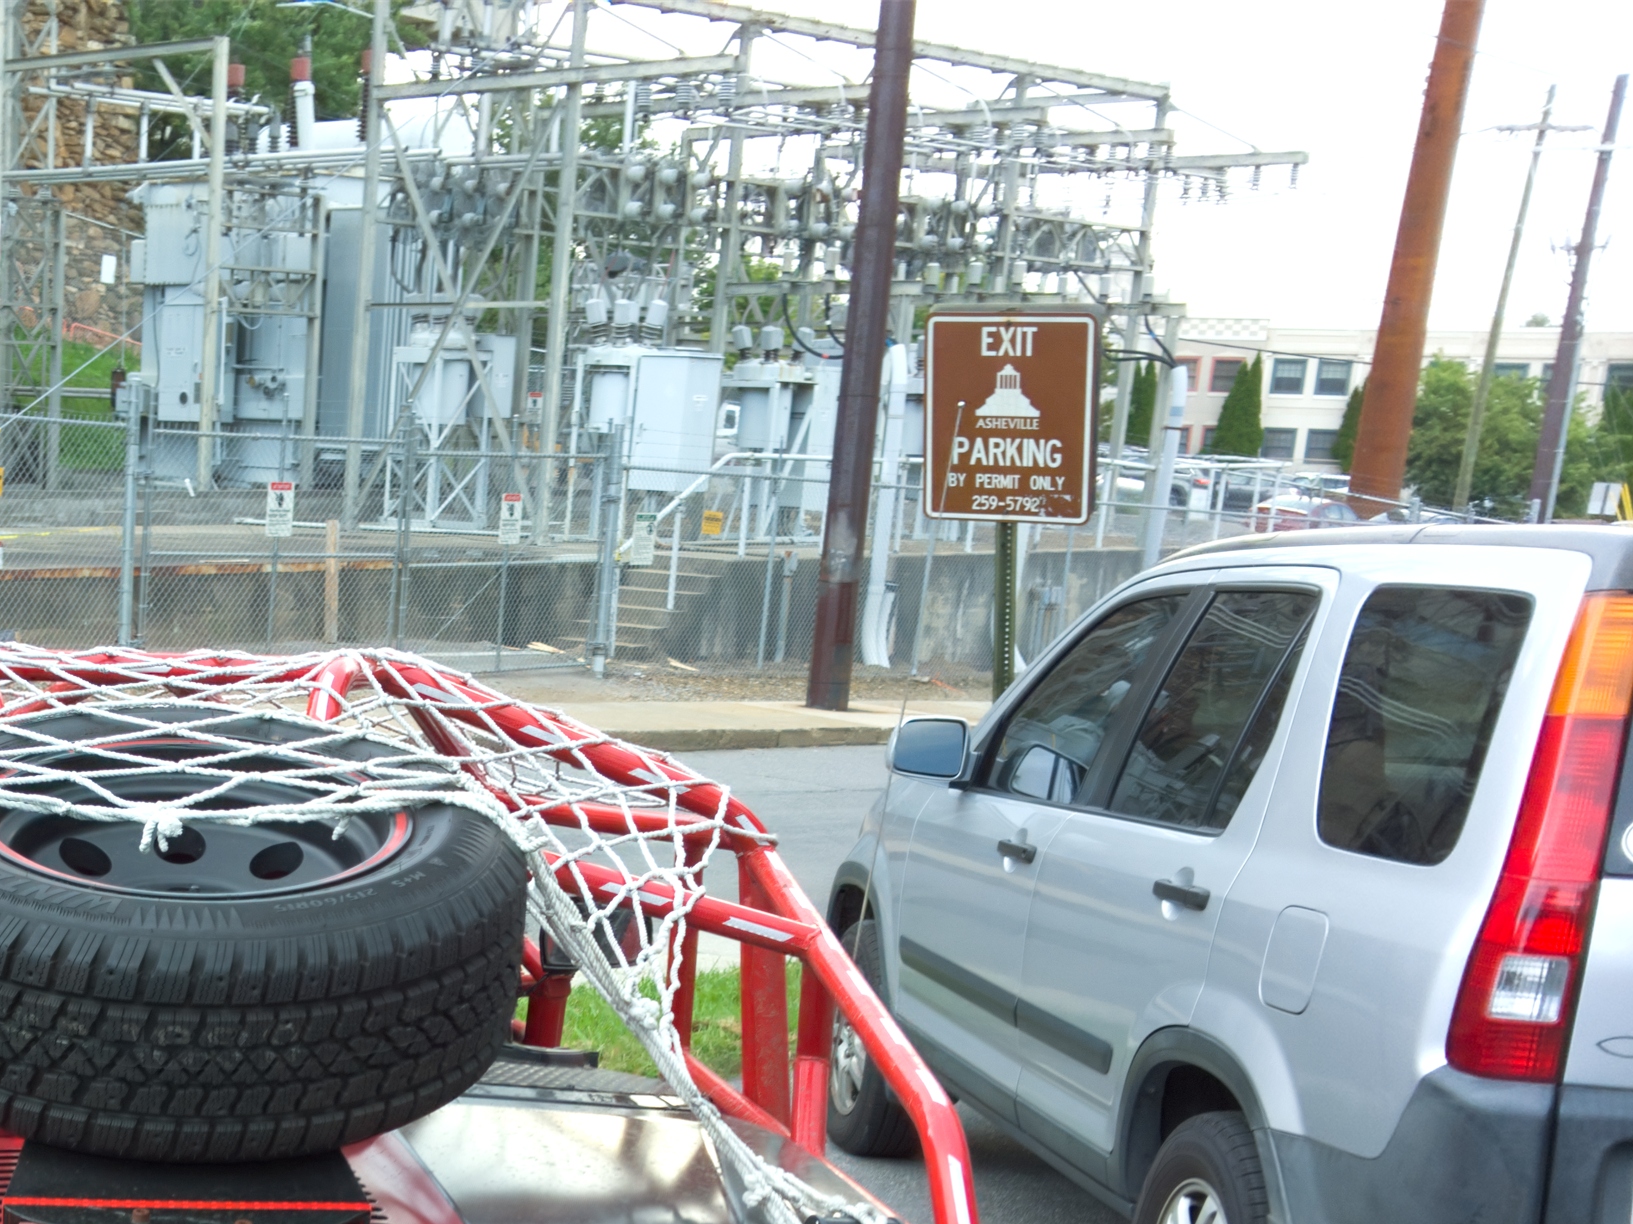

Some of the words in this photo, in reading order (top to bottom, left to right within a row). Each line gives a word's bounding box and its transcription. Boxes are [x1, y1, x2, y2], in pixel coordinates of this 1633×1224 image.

[980, 326, 1039, 357] EXIT
[975, 418, 1040, 430] ASHEVILLE
[951, 437, 1063, 468] PARKING
[948, 472, 967, 488] BY
[975, 473, 1021, 489] PERMIT
[1029, 475, 1065, 491] ONLY
[971, 494, 1041, 513] 259-5792
